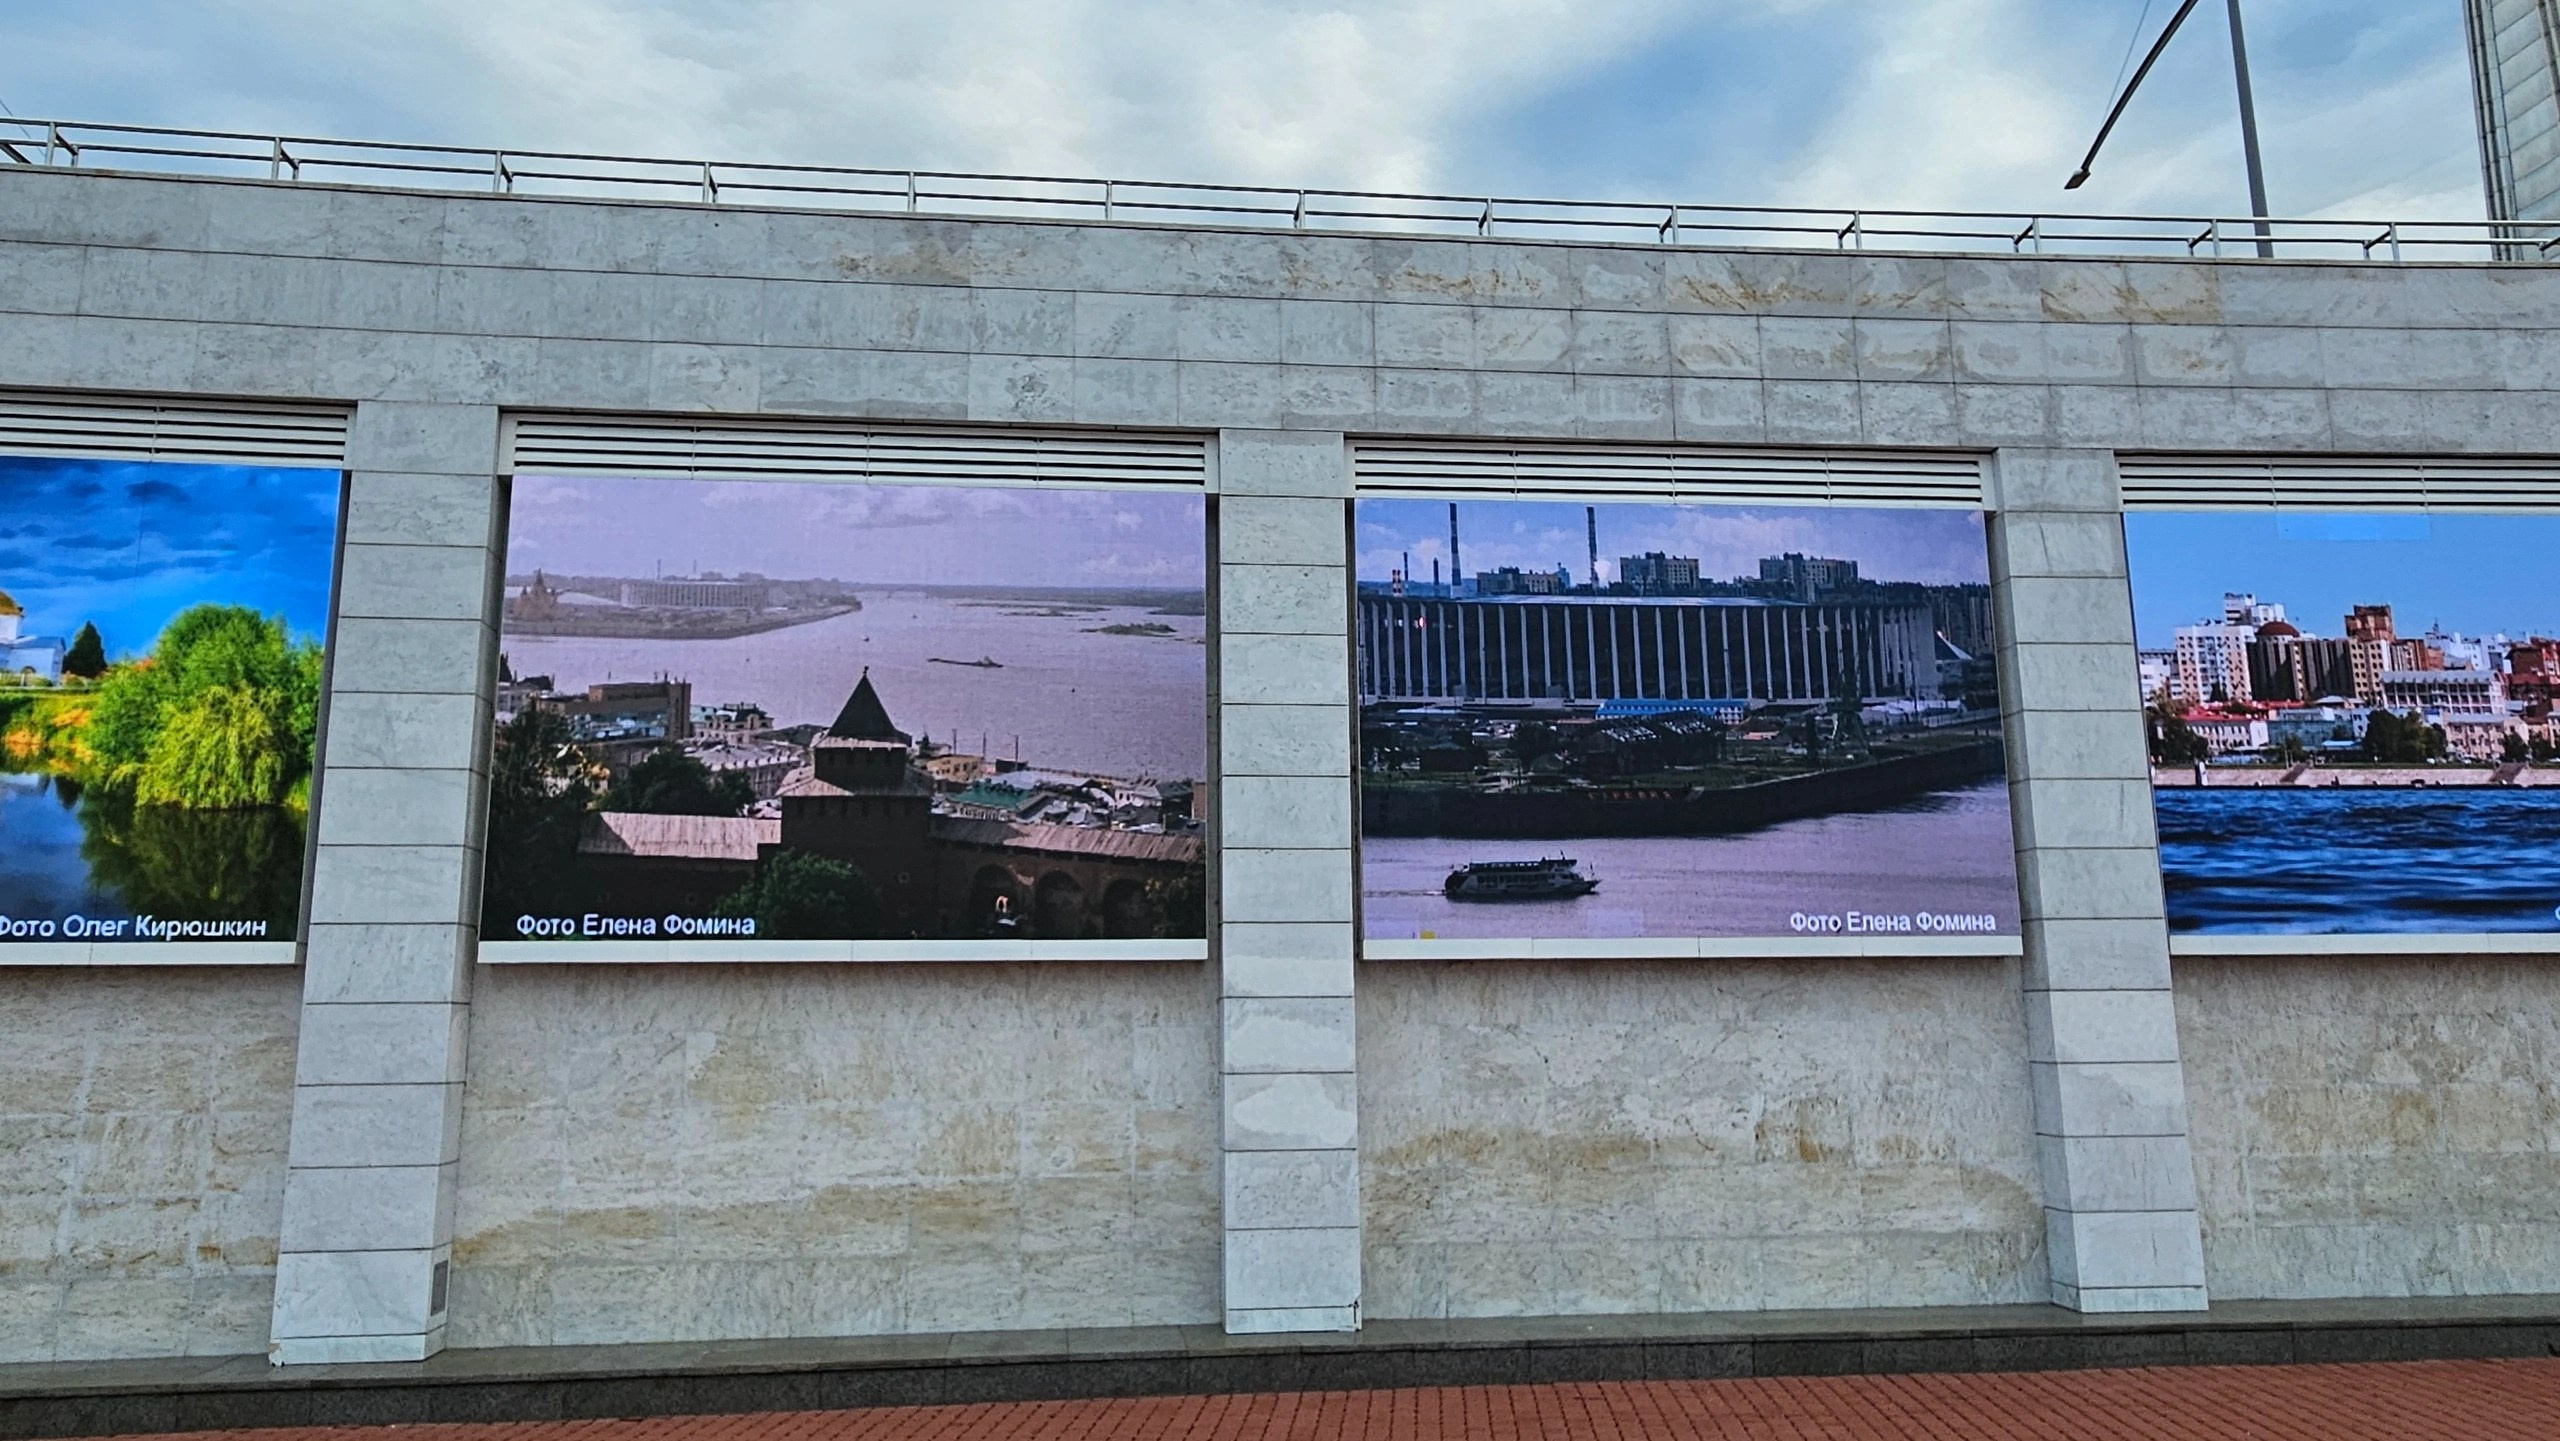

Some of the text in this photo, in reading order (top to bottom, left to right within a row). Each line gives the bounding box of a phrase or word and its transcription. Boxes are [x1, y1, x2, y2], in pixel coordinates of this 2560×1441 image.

[62, 914, 128, 937] Олег
[135, 915, 267, 941] Кирюшкин
[516, 914, 756, 935] Фото Елена Фомина
[1790, 911, 1996, 932] Фото Елена Фомина
